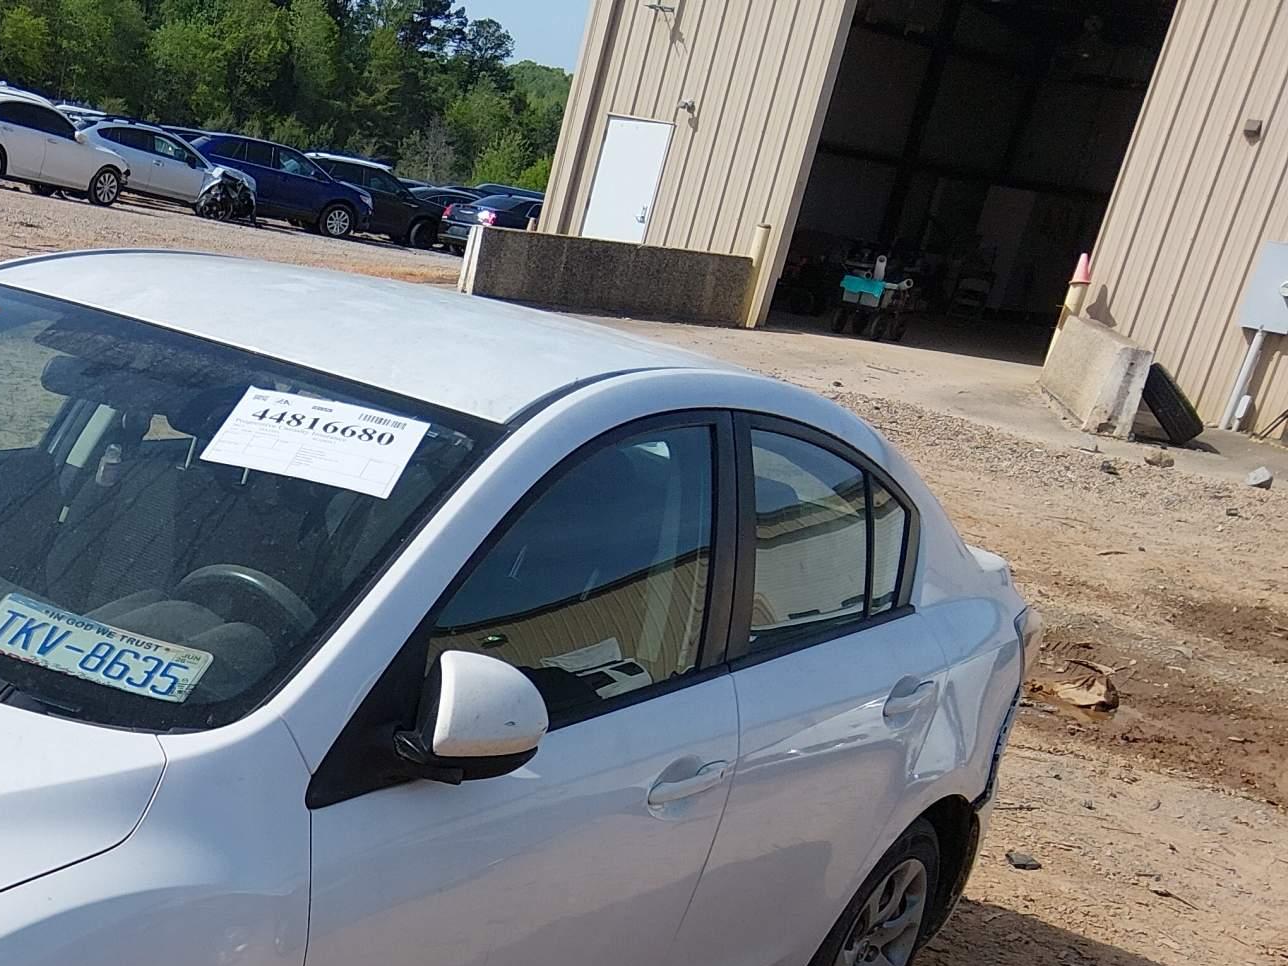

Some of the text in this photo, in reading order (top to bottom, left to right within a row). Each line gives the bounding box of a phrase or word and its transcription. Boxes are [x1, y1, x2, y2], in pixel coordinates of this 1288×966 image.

[252, 407, 396, 447] 44816680
[48, 610, 162, 653] IN GOD WE TRUST
